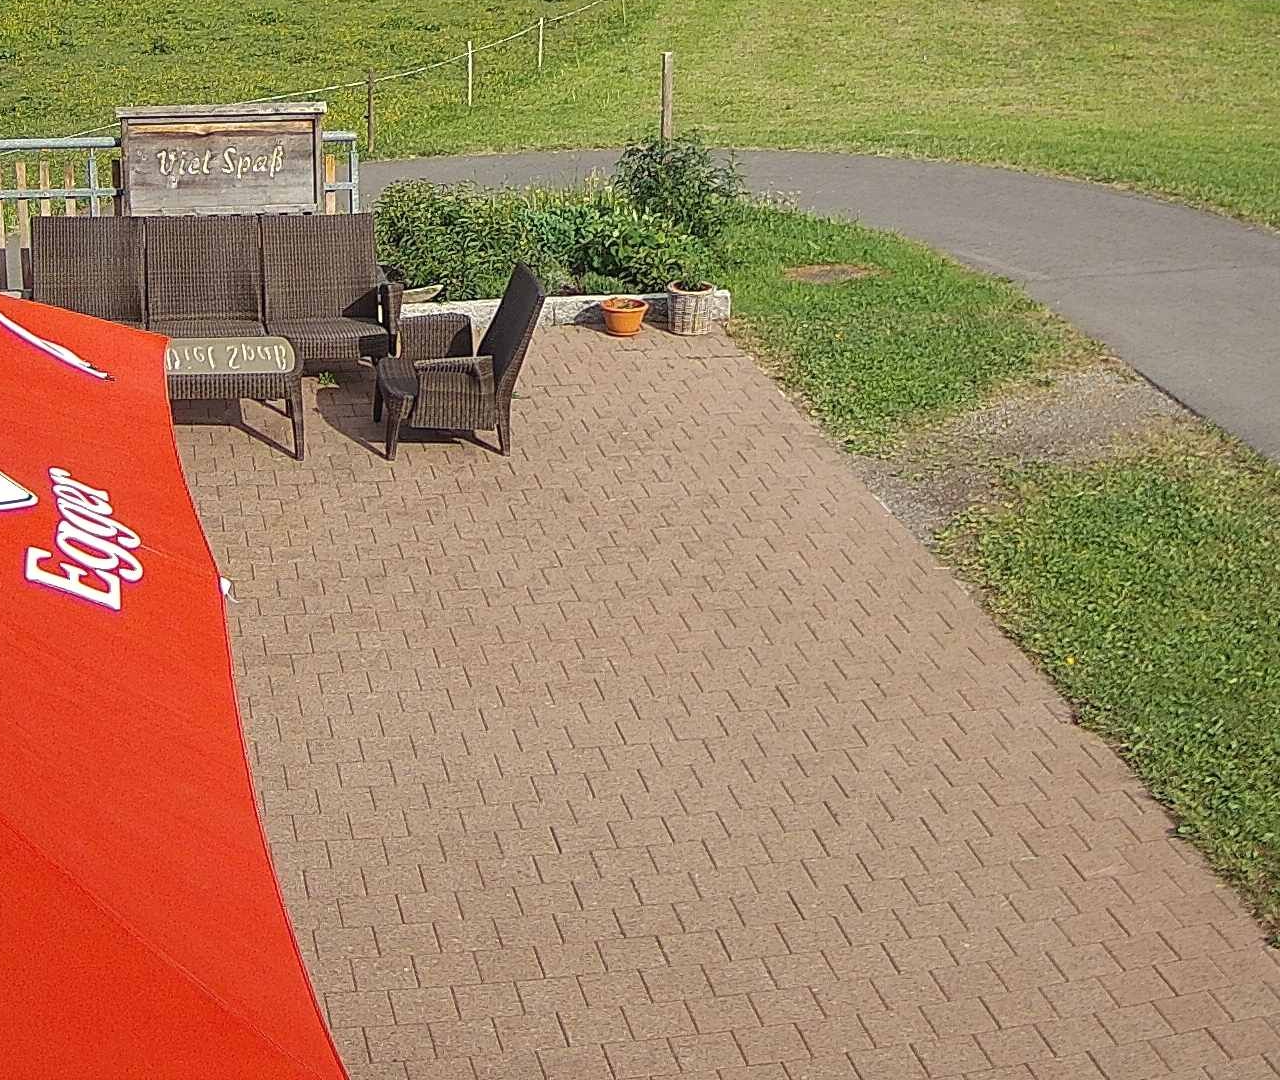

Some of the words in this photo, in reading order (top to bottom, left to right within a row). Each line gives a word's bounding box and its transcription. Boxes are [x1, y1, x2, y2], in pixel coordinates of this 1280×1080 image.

[156, 149, 213, 176] Viel
[221, 144, 285, 180] Spaß
[24, 466, 144, 611] Egger
